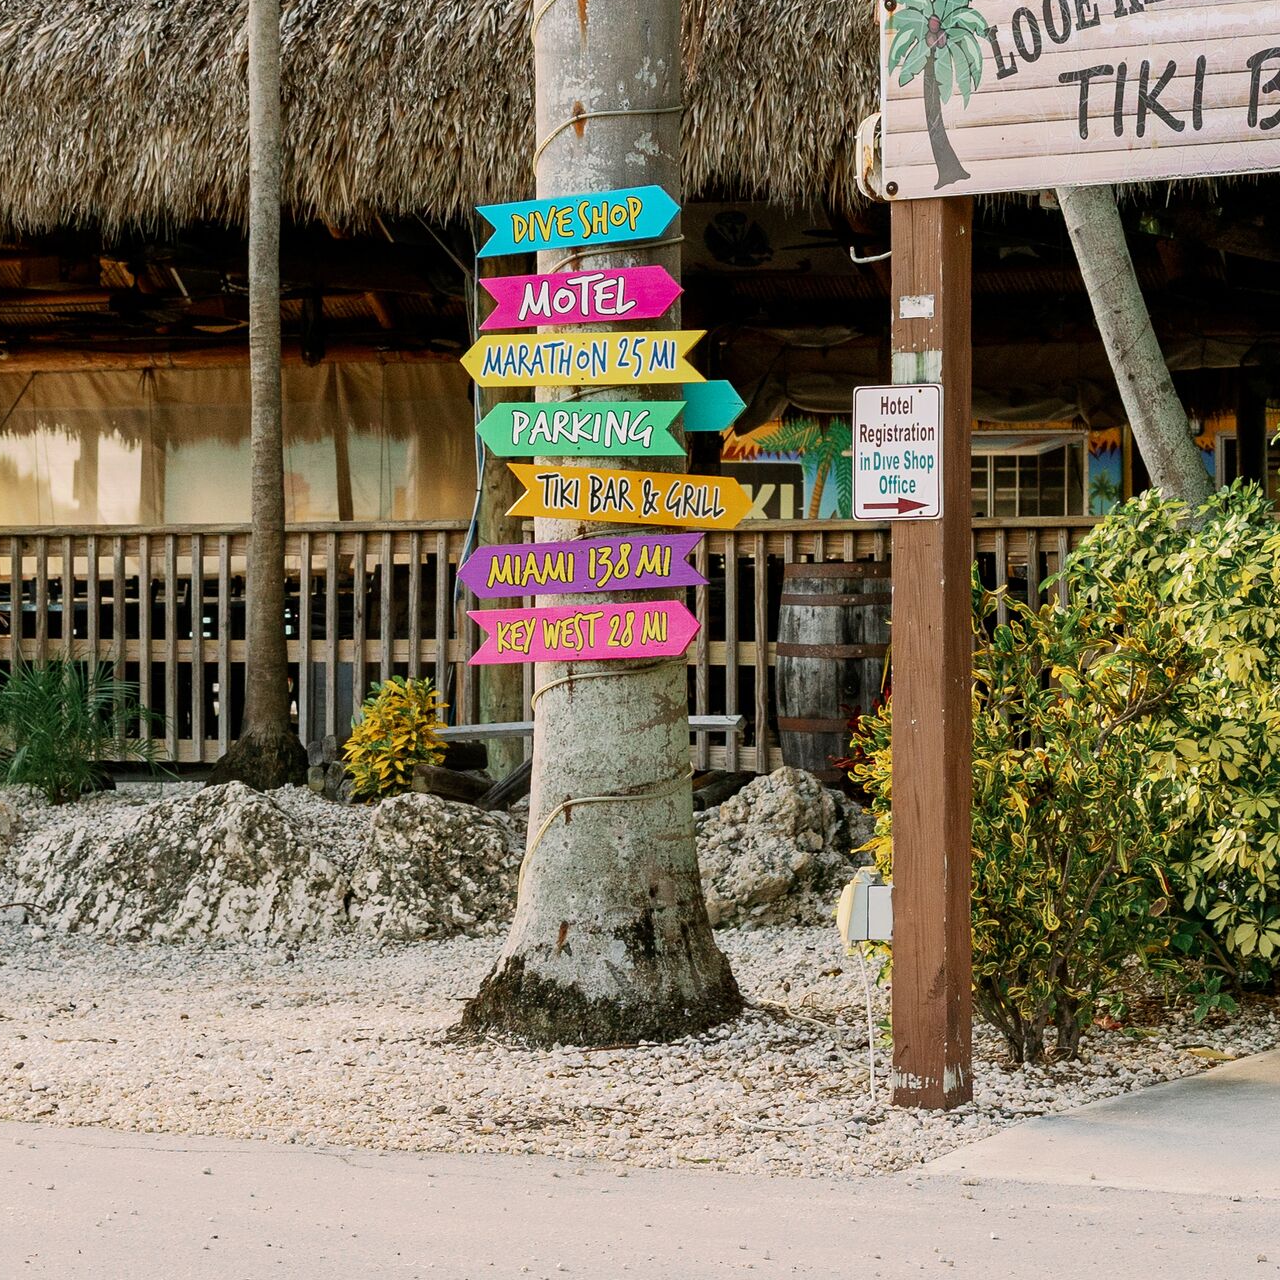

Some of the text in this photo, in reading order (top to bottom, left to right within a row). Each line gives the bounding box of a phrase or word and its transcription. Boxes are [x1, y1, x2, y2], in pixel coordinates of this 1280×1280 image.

[1058, 54, 1207, 140] TIKI
[511, 196, 643, 244] DIVE SHOP
[518, 273, 637, 321] MOTEL
[481, 337, 677, 378] MARATHON 25 MI
[880, 395, 913, 415] Hotel
[511, 410, 654, 448] PARKING
[859, 422, 935, 448] Registration
[860, 450, 934, 474] in Dive Shop
[536, 473, 725, 518] TIKI BAR & GRILL
[879, 475, 916, 495] Office
[486, 542, 672, 589] MIAMI 138 MI
[496, 610, 668, 654] KEY WEST 28 MI
